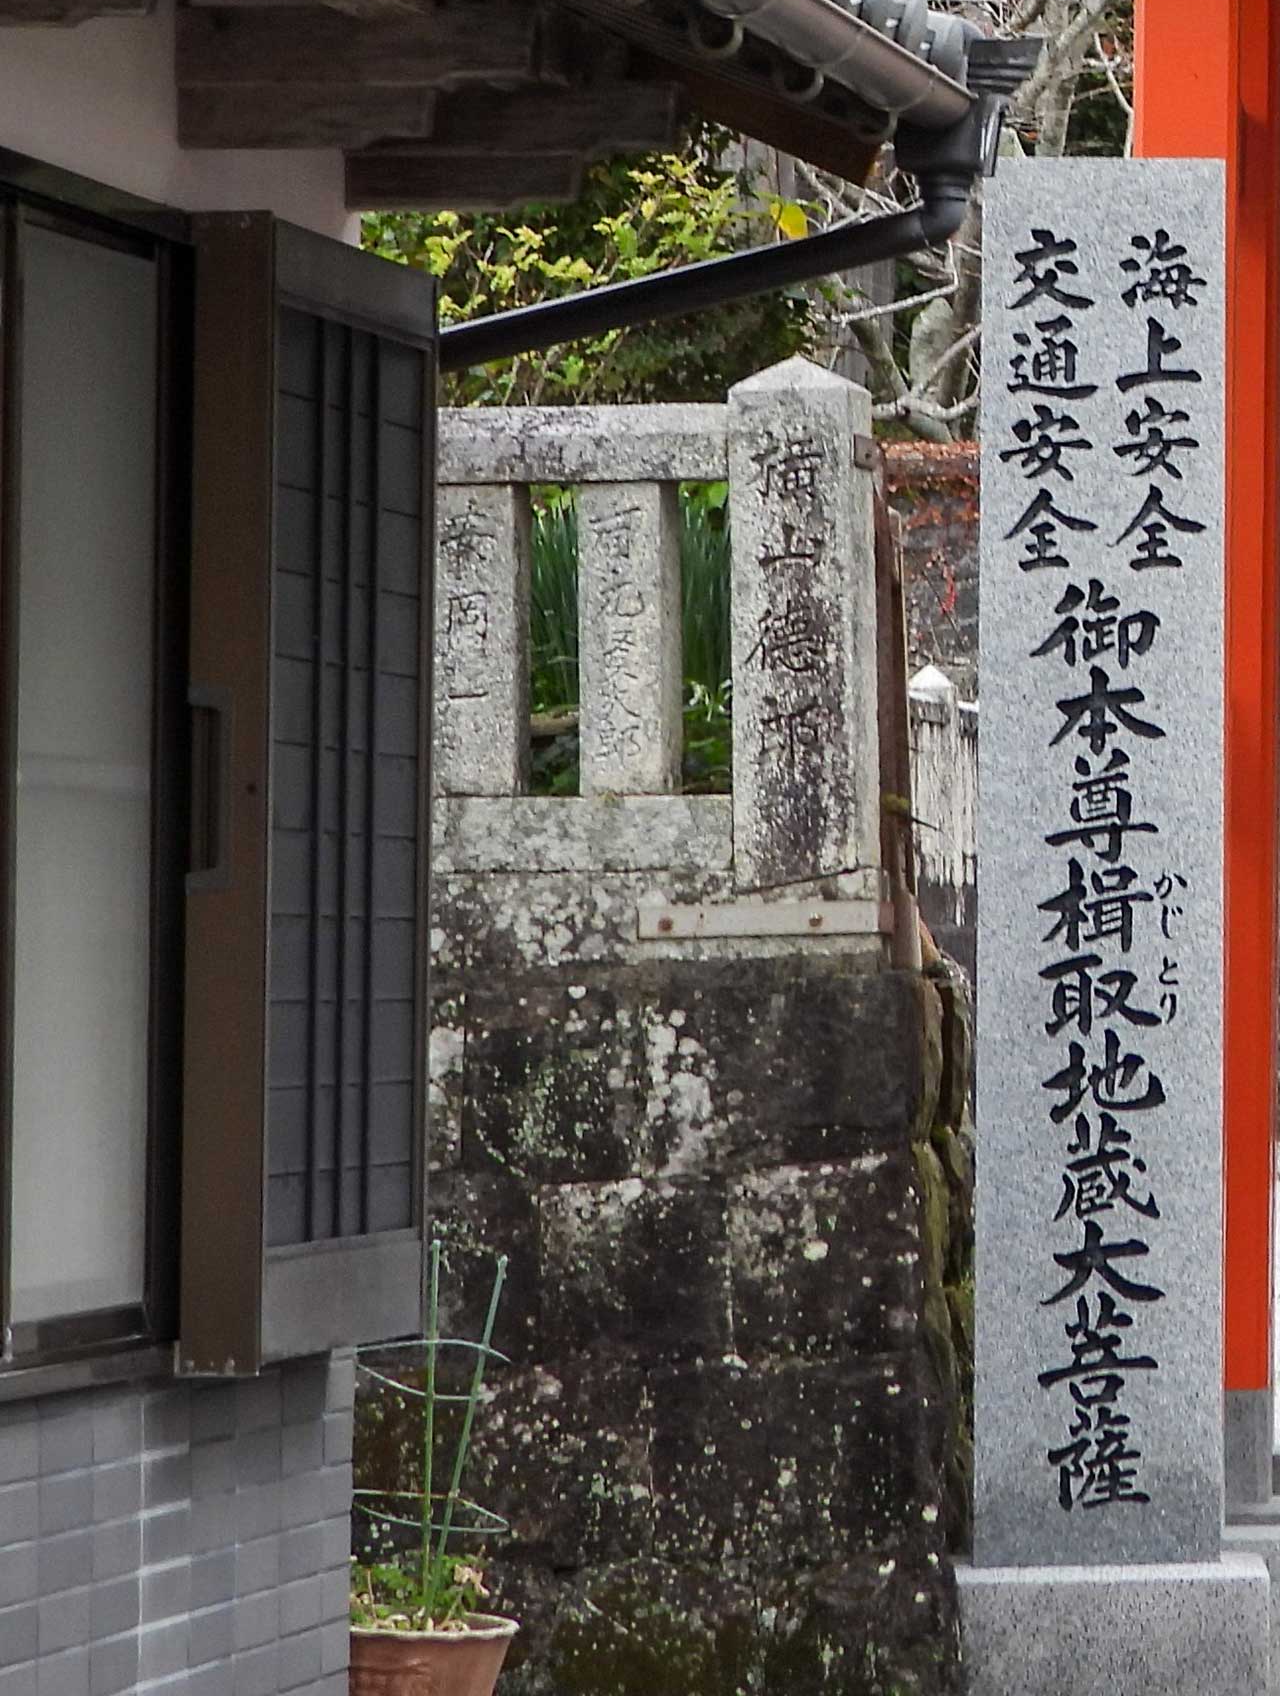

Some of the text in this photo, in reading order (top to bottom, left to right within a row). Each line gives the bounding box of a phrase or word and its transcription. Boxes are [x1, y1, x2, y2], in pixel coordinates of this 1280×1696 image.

[1000, 228, 1098, 572] 交通安全
[1112, 228, 1207, 572] 海上安全
